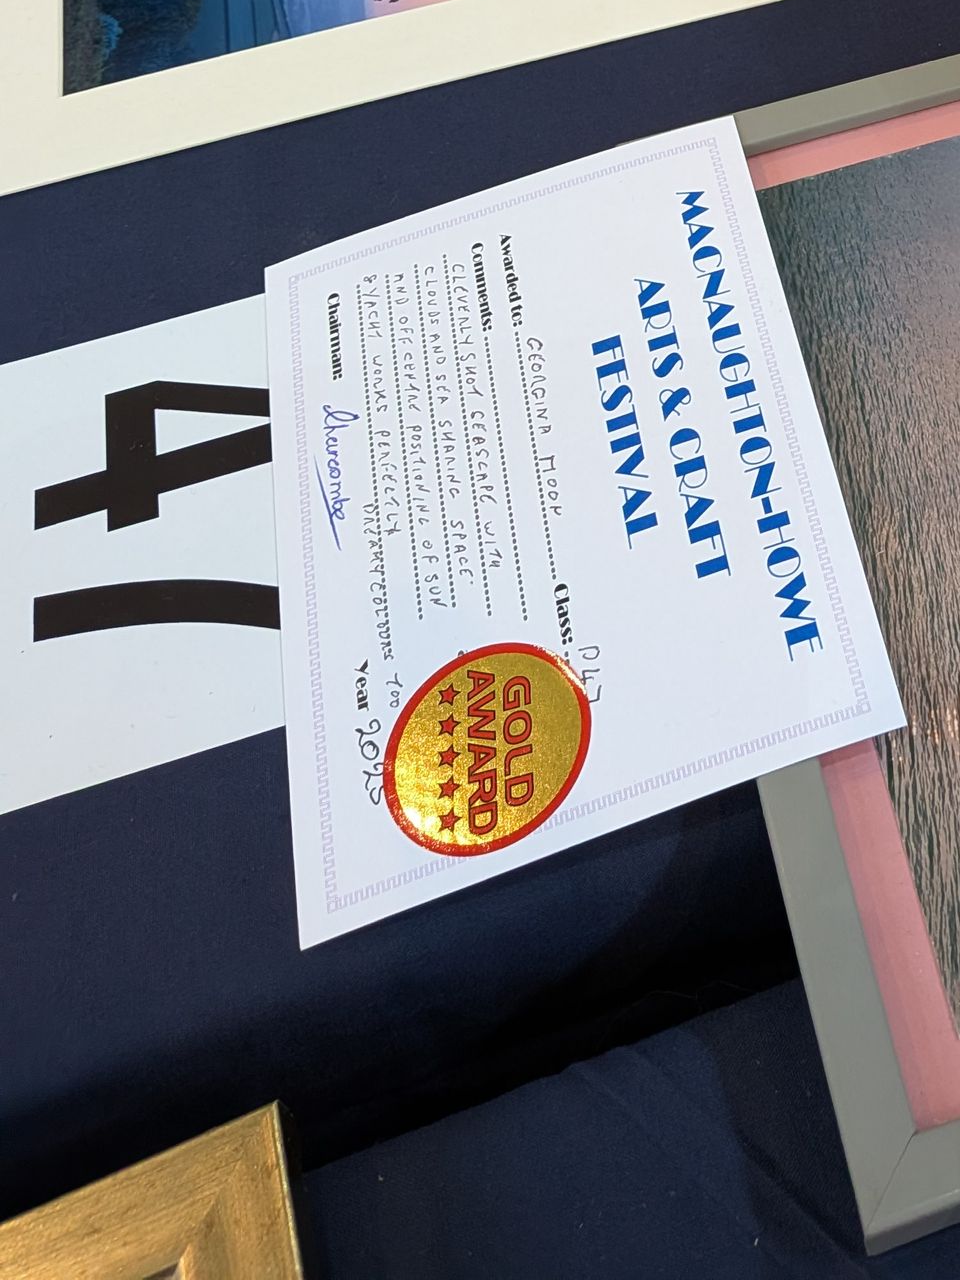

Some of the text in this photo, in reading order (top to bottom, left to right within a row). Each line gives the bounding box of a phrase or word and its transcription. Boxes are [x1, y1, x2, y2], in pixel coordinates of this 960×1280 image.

[393, 273, 409, 305] AND
[424, 265, 440, 325] CLOUDS
[470, 242, 493, 332] Comments:
[499, 233, 523, 303] Awarded
[326, 292, 343, 381] Chairman:
[398, 316, 414, 345] OFF
[508, 304, 524, 328] to:
[429, 334, 447, 365] AND
[434, 373, 452, 405] SEA
[591, 334, 659, 550] FESTIVAL
[633, 278, 732, 579] ARTS & CRAFT
[675, 190, 824, 662] MACNAUGHTON-HOWE
[470, 409, 498, 505] SEASCAPE
[421, 538, 440, 564] OF
[483, 520, 503, 568] WITH
[423, 572, 448, 608] SUN
[553, 582, 573, 645] Class:
[354, 658, 369, 712] Year
[466, 669, 499, 836] AWARD
[502, 675, 534, 808] GOLD
